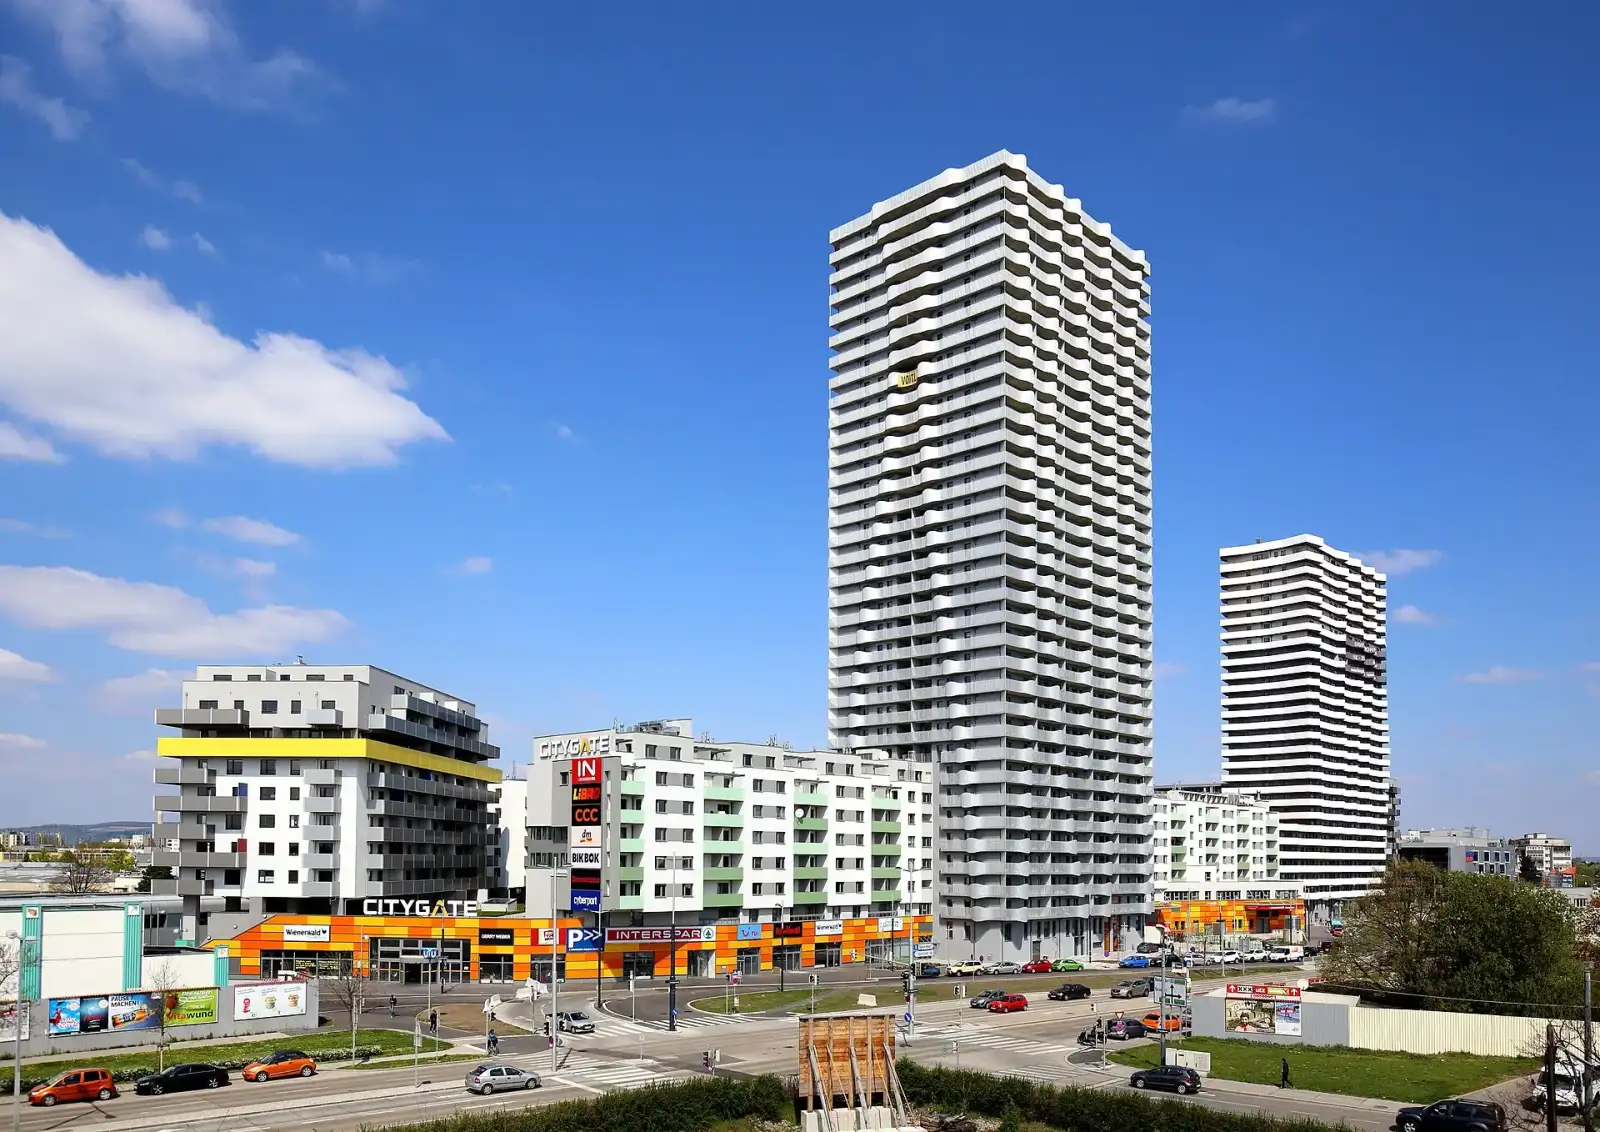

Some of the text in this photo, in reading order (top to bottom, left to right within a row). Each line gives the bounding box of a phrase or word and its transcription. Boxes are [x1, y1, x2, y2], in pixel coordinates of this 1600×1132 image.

[539, 735, 610, 759] CITYGATE
[577, 759, 596, 777] IN
[575, 808, 599, 822] CCC
[581, 829, 592, 839] dm
[572, 852, 600, 864] BIK BOK
[573, 895, 598, 905] cyberport
[363, 898, 478, 917] CITYGATE
[285, 928, 321, 936] Wienerwald
[616, 930, 701, 940] INTERSPAR
[568, 929, 584, 949] P
